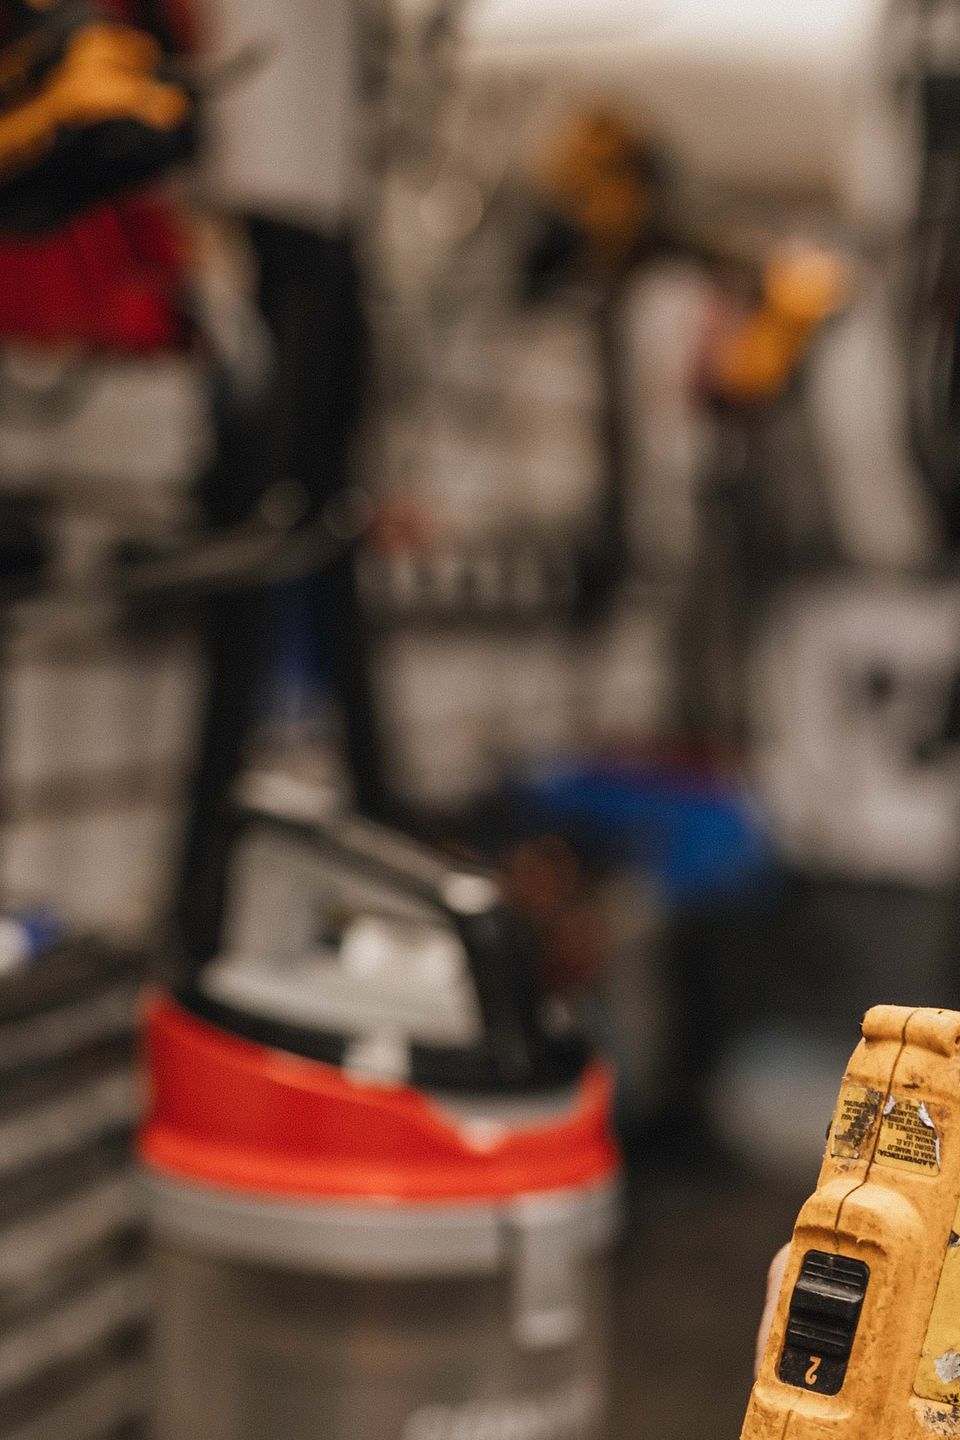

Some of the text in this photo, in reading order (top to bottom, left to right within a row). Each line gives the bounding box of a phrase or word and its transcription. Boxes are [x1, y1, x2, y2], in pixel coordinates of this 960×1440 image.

[887, 1144, 911, 1155] MANEJO
[902, 1140, 913, 1148] LEA
[805, 1355, 822, 1385] 2
